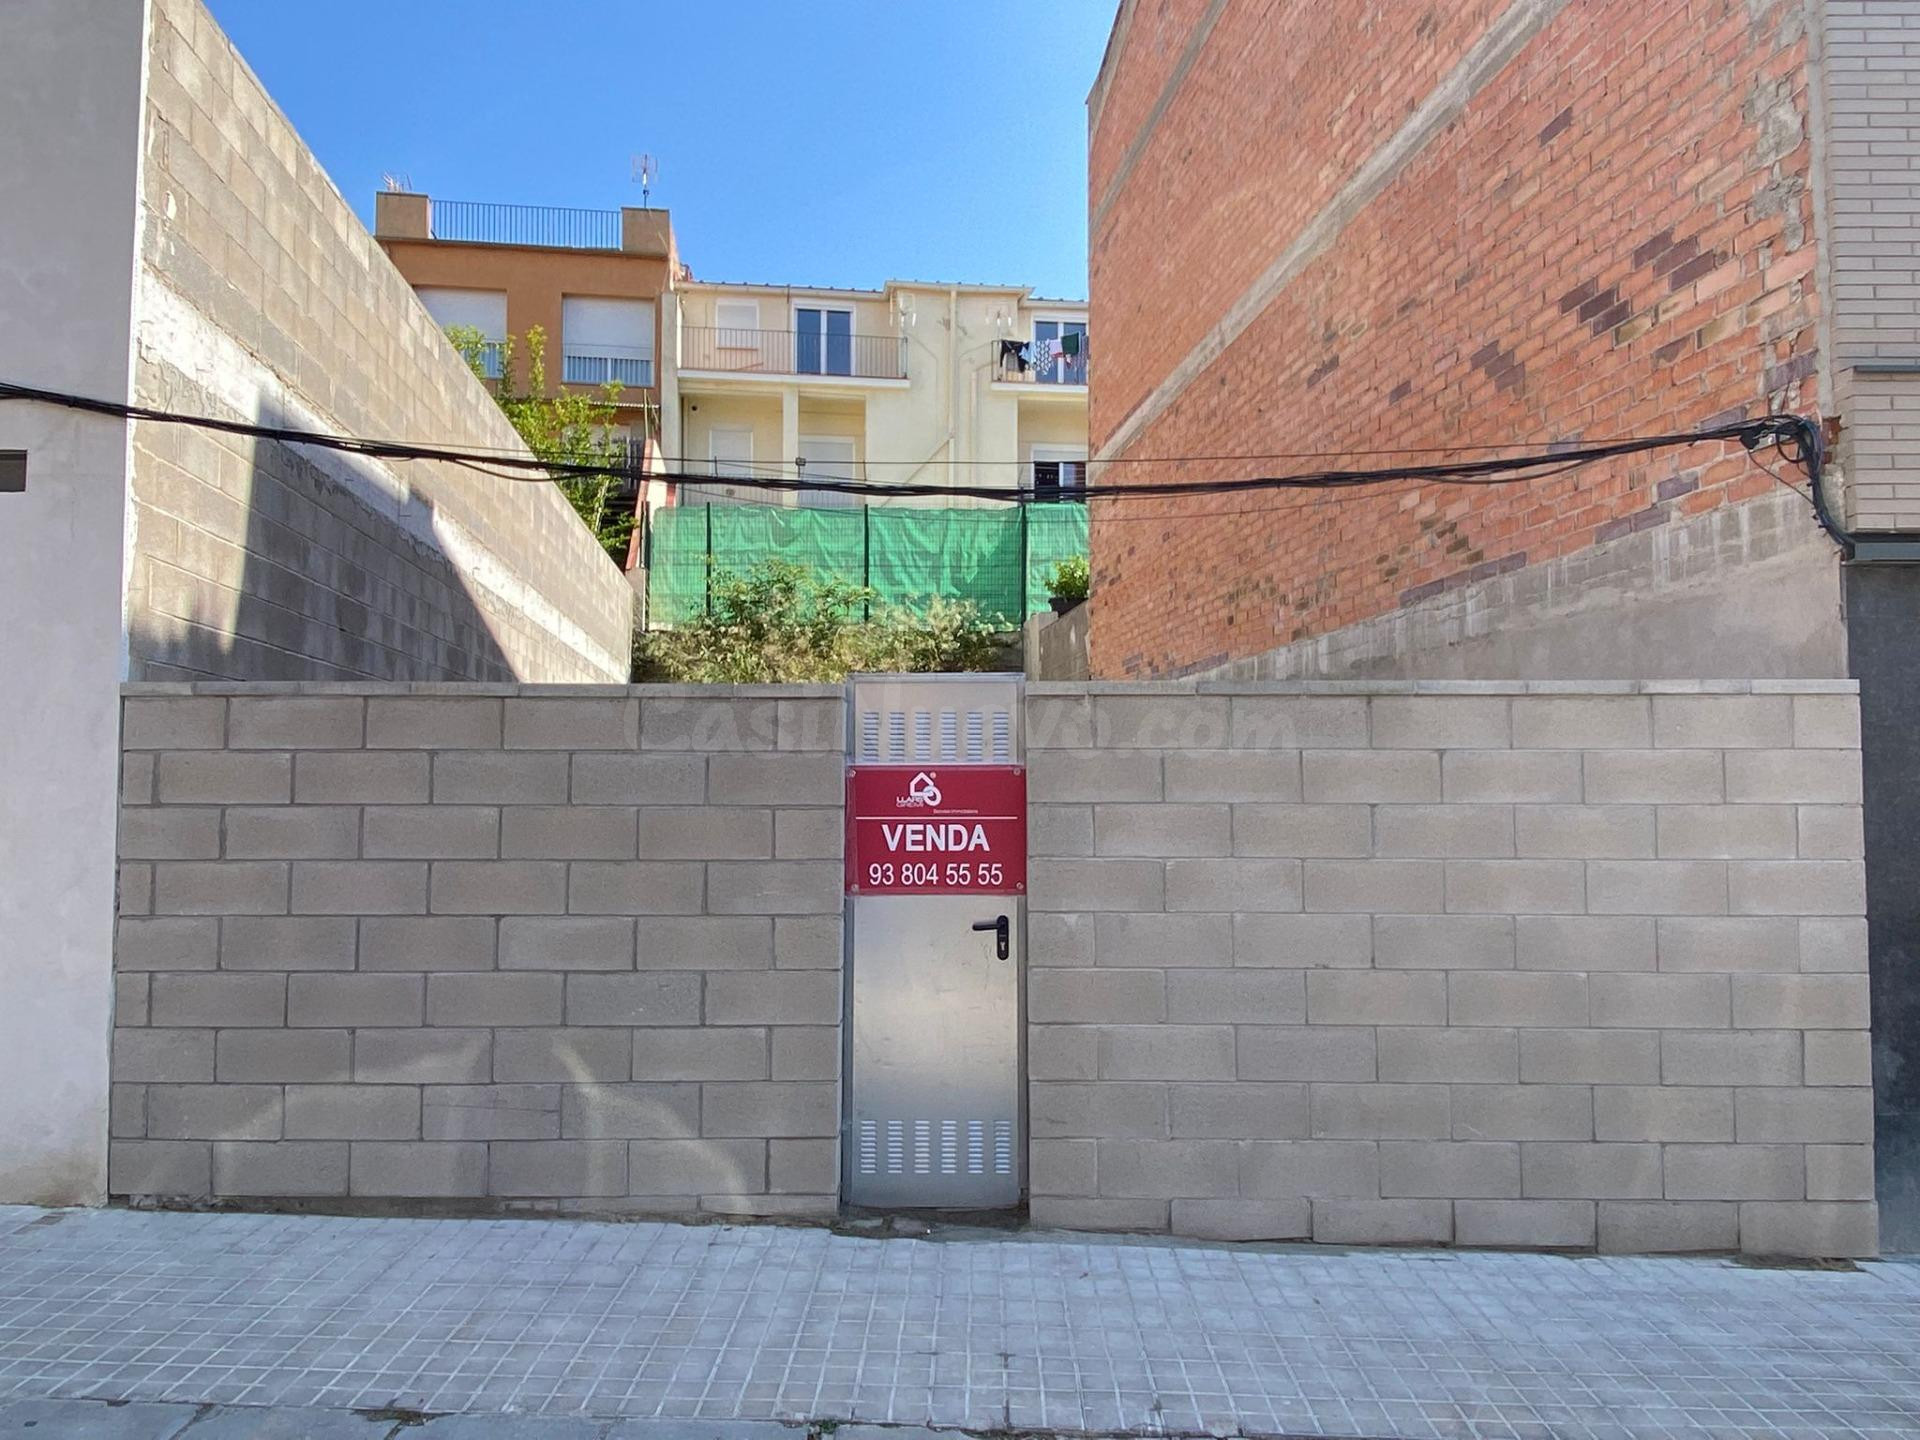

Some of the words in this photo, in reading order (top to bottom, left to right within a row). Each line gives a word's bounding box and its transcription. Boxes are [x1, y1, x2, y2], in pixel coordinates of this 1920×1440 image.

[881, 824, 991, 852] VENDA
[868, 863, 895, 885] 93
[901, 863, 939, 885] 804
[945, 863, 972, 885] 55
[977, 863, 1003, 885] 55
